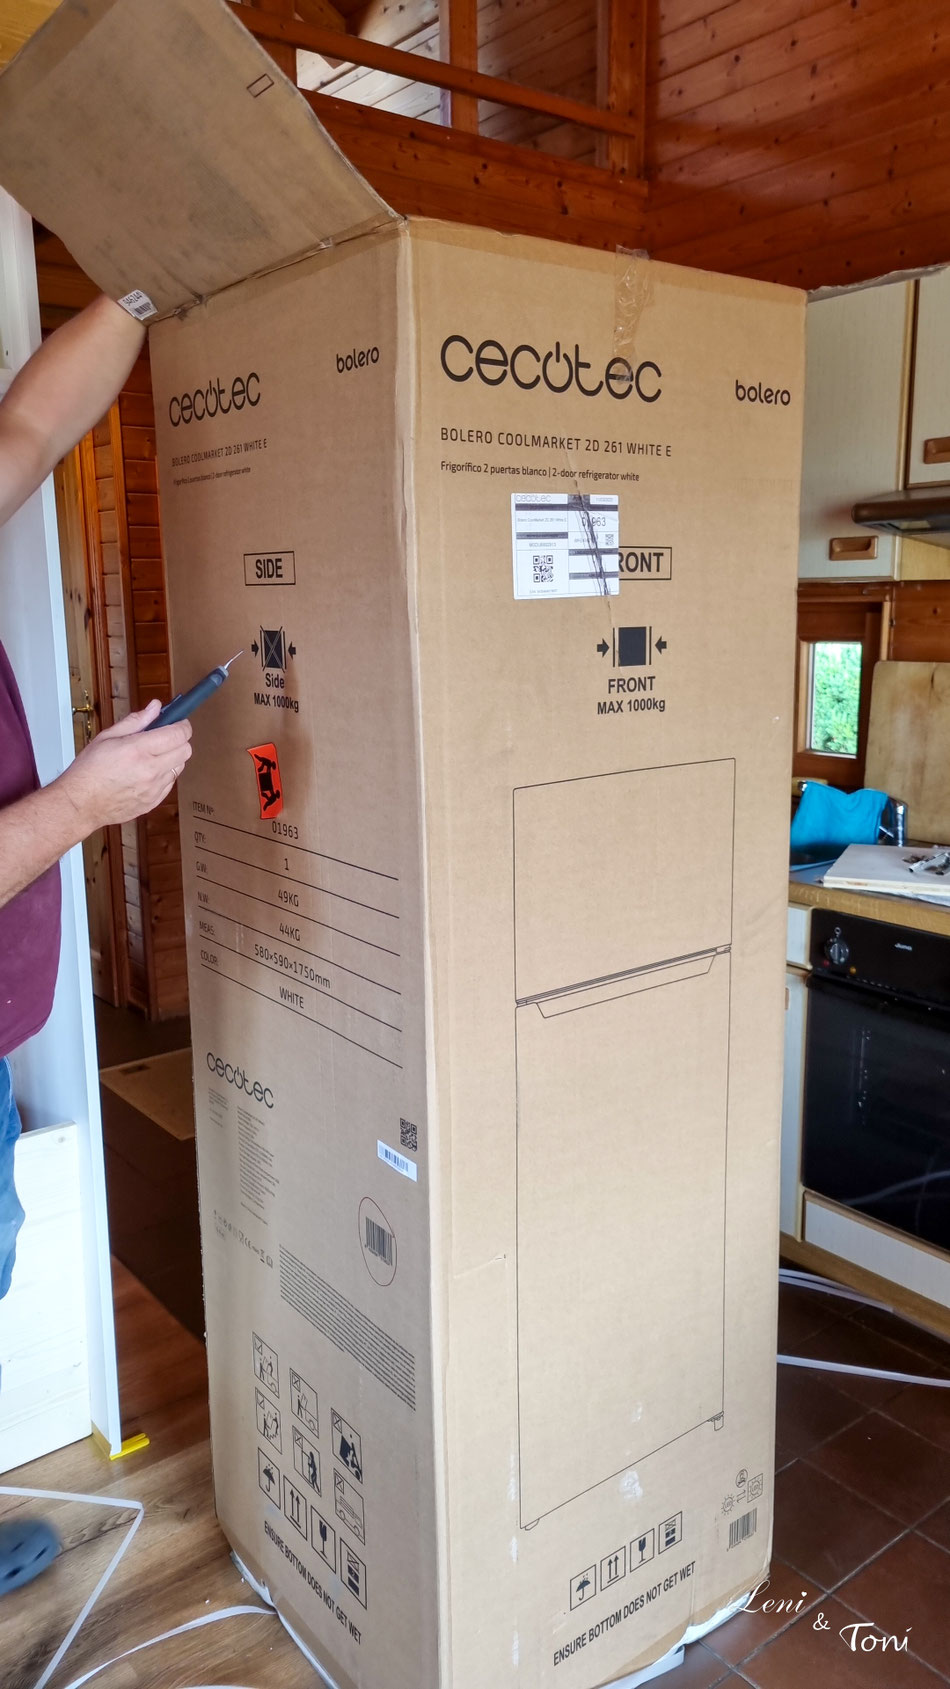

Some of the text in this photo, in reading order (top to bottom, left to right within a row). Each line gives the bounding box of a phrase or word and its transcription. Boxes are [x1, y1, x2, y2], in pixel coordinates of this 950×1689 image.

[335, 346, 380, 373] bolero
[440, 334, 663, 404] cecotec
[168, 372, 261, 427] cecotec
[735, 379, 791, 406] bolero
[171, 438, 268, 467] BOLERO COOLMARKET 2D 261 WHITE E
[440, 427, 672, 457] BOLERO COOLMARKET 2D 261 WHITE E
[440, 461, 482, 474] Frigorífico
[483, 463, 489, 473] 2
[490, 465, 521, 476] puertas
[521, 466, 548, 477] blanco
[552, 467, 577, 478] 2-door
[578, 469, 620, 482] refrigerator
[620, 472, 640, 482] white
[581, 516, 607, 527] 0963
[255, 558, 284, 579] SIDE
[618, 552, 664, 573] RONT
[266, 674, 285, 688] Side
[608, 675, 656, 694] FRONT
[253, 692, 299, 713] MAX 1000kg
[597, 697, 666, 715] MAX 1000kg
[193, 801, 206, 812] ITEM
[271, 820, 299, 840] 01963
[284, 858, 290, 871] 1
[277, 889, 299, 907] 49KG
[279, 922, 300, 942] 44KG
[279, 986, 304, 1009] WHITE
[206, 1052, 274, 1109] cecotec
[264, 1519, 362, 1645] ENSURE BOTTOM DOES NOT GET WET
[553, 1560, 697, 1667] ENSURE BOTTOM DOES NOT GET WET
